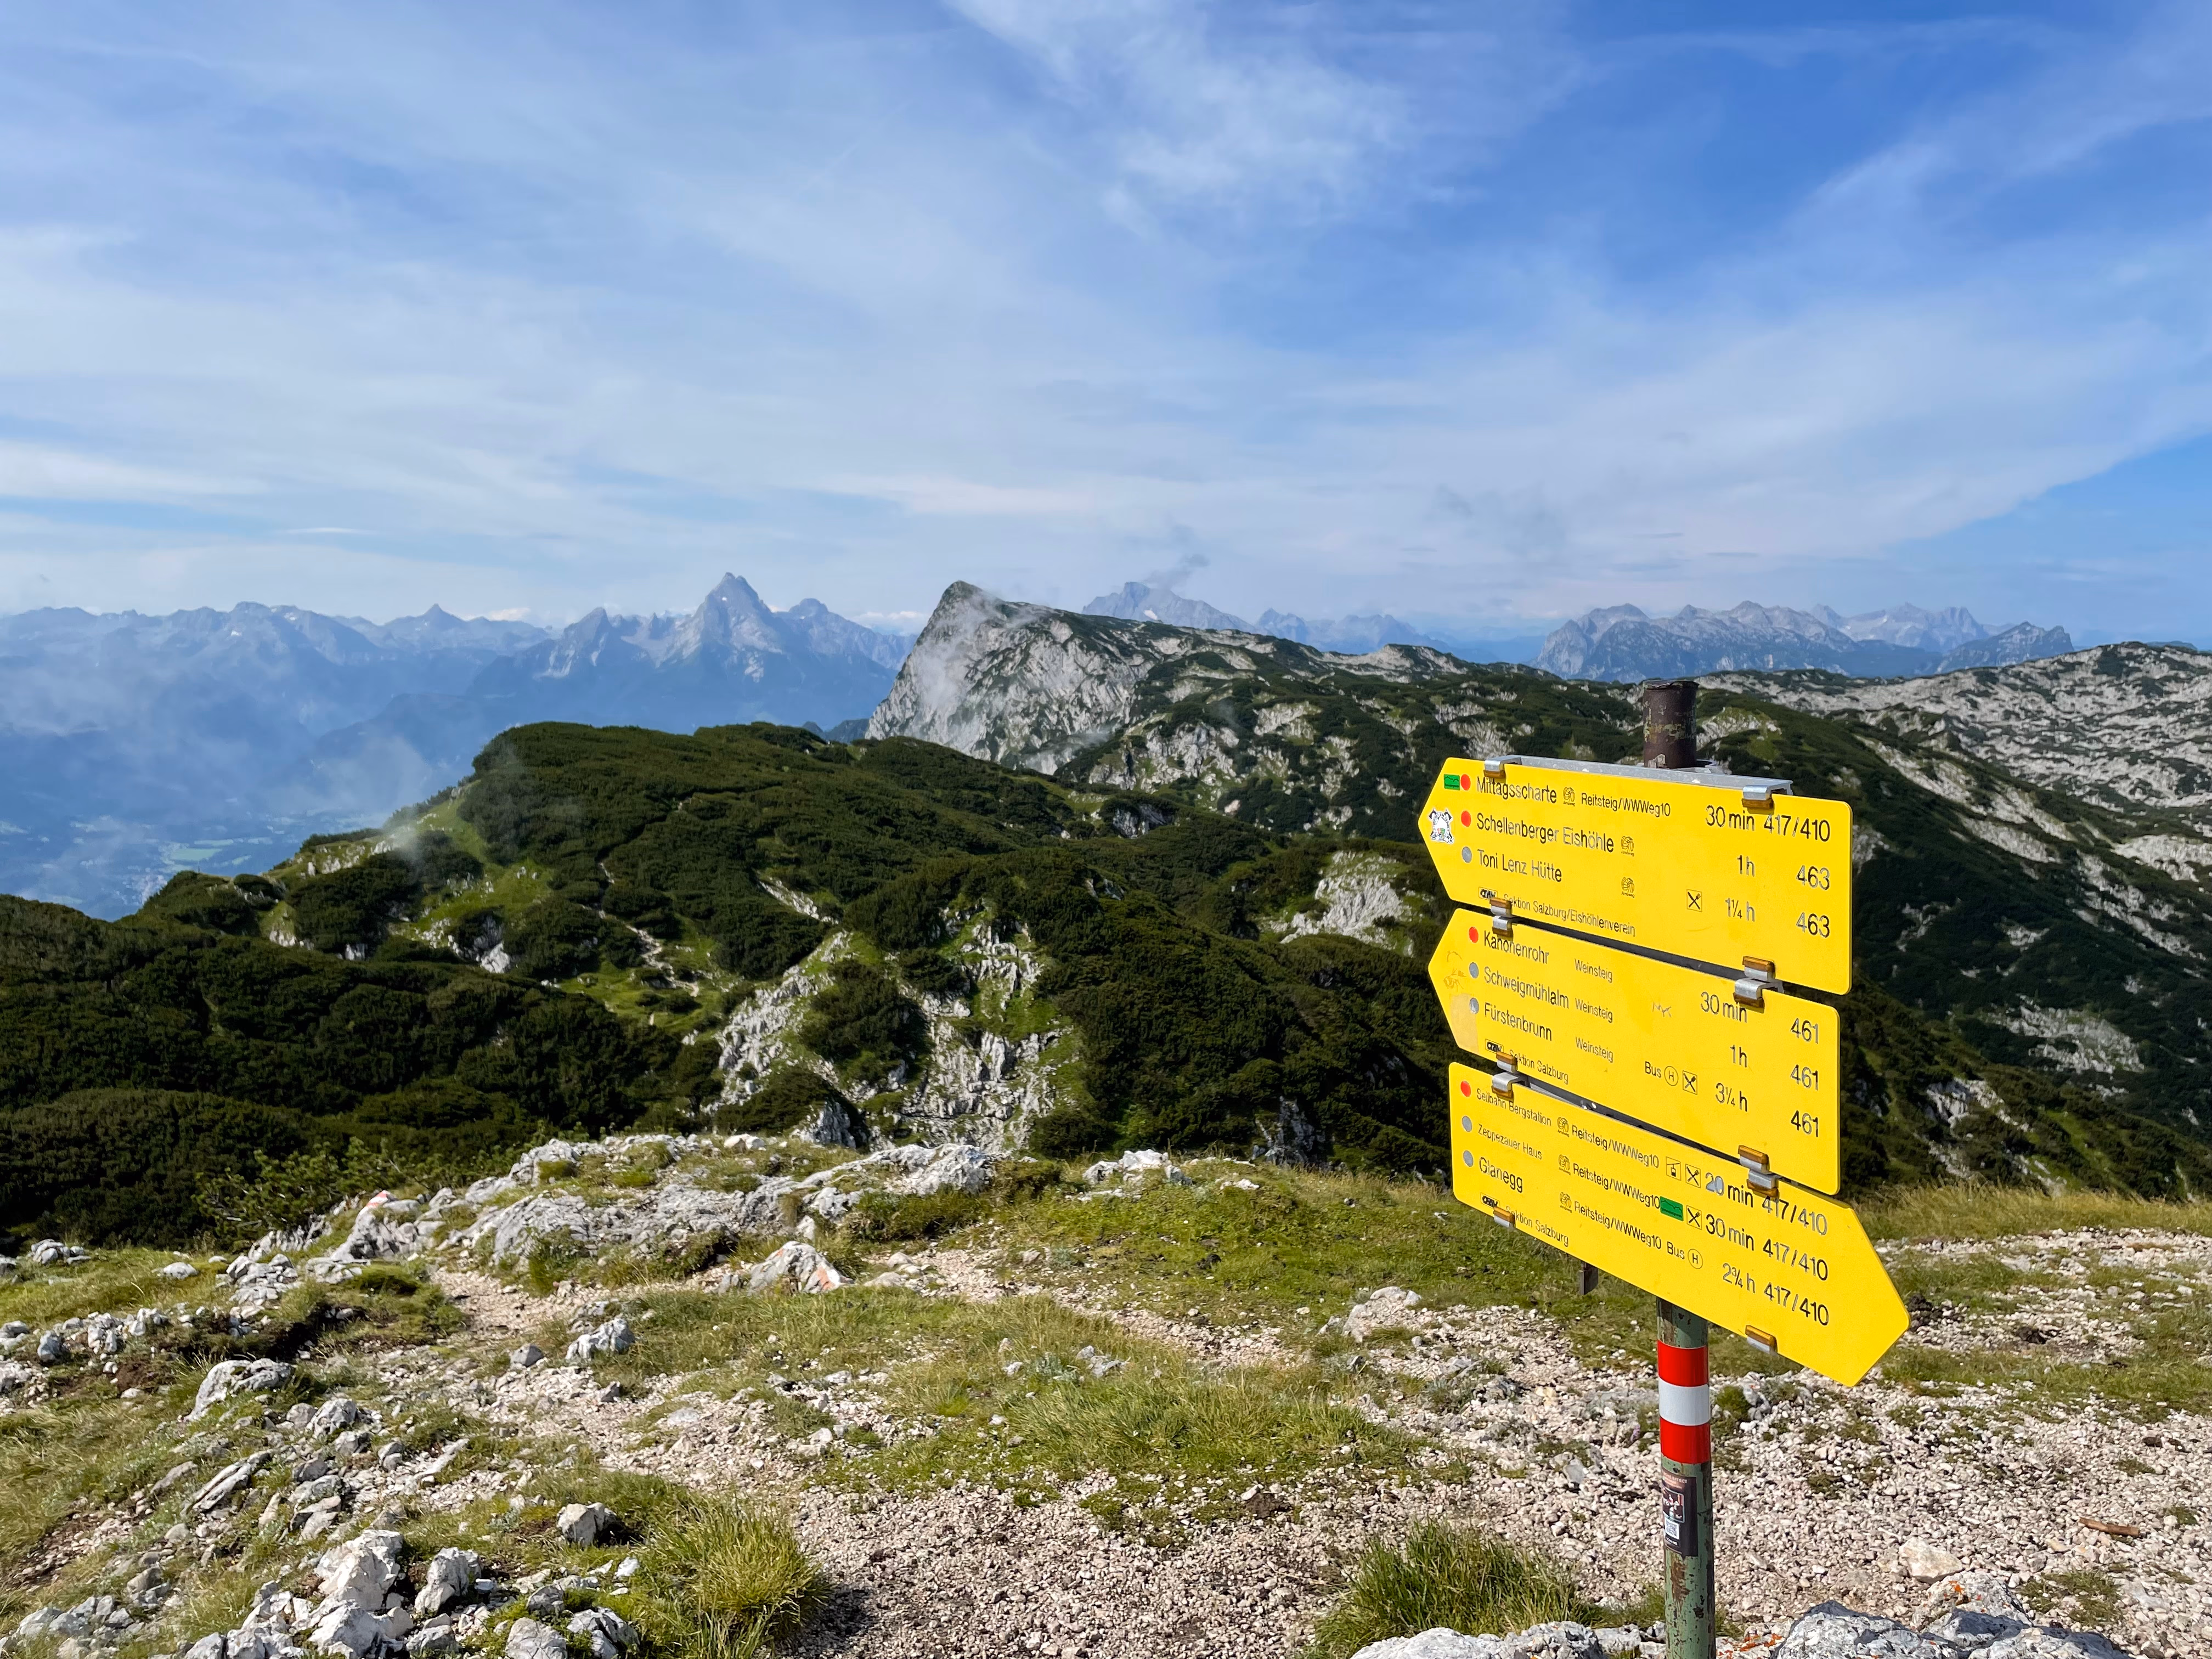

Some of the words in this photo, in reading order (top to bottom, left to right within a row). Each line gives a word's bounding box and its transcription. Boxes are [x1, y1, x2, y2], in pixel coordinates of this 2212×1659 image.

[1477, 776, 1557, 804] Mittagsscharte
[1581, 792, 1671, 817] Reitsteig/WWWeg10
[1706, 805, 1725, 827] 30
[1729, 810, 1754, 831] min
[1764, 814, 1830, 842] 417/410
[1477, 812, 1559, 844] Schellenberger
[1563, 826, 1614, 853] Eishöhle
[1796, 865, 1830, 890] 463
[1477, 849, 1498, 870] Toni
[1502, 854, 1527, 875] Lenz
[1531, 860, 1562, 882] Hütte
[1747, 901, 1755, 922] h
[1796, 912, 1830, 938] 463
[1533, 901, 1636, 937] Salzburg/Eishöhlenverein
[1484, 967, 1569, 1009] Schweigmühlalm
[1575, 998, 1613, 1023] Weinsteig
[1790, 1065, 1818, 1091] 461
[1485, 930, 1549, 964] Kanonenrohr
[1575, 958, 1613, 983] Weinsteig
[1701, 991, 1719, 1015] 30
[1723, 1001, 1747, 1023] min
[1790, 1018, 1818, 1044] 461
[1485, 1002, 1552, 1041] Fürstenbrunn
[1575, 1036, 1613, 1063] Weinsteig
[1645, 1061, 1662, 1079] Bus
[1739, 1091, 1747, 1112] h
[1791, 1110, 1818, 1137] 461
[1537, 1060, 1568, 1085] Salzburg
[1478, 1124, 1520, 1150] Zeppezauer
[1522, 1142, 1542, 1160] Haus
[1573, 1163, 1660, 1209] Reitsteig/WWWeg10
[1706, 1214, 1725, 1238] 30
[1729, 1228, 1754, 1251] min
[1763, 1239, 1828, 1281] 417/410
[1509, 1101, 1551, 1126] Bergstation
[1572, 1125, 1659, 1169] Reitsteig/WWWeg10
[1705, 1172, 1725, 1196] 20
[1728, 1185, 1753, 1208] min
[1762, 1196, 1827, 1235] 417/410
[1479, 1157, 1523, 1193] Glanegg
[1574, 1200, 1661, 1250] Reitsteig/WWWeg10
[1667, 1241, 1685, 1260] Bus
[1747, 1272, 1756, 1294] h
[1763, 1282, 1829, 1326] 417/410
[1535, 1220, 1569, 1248] Salzburg
